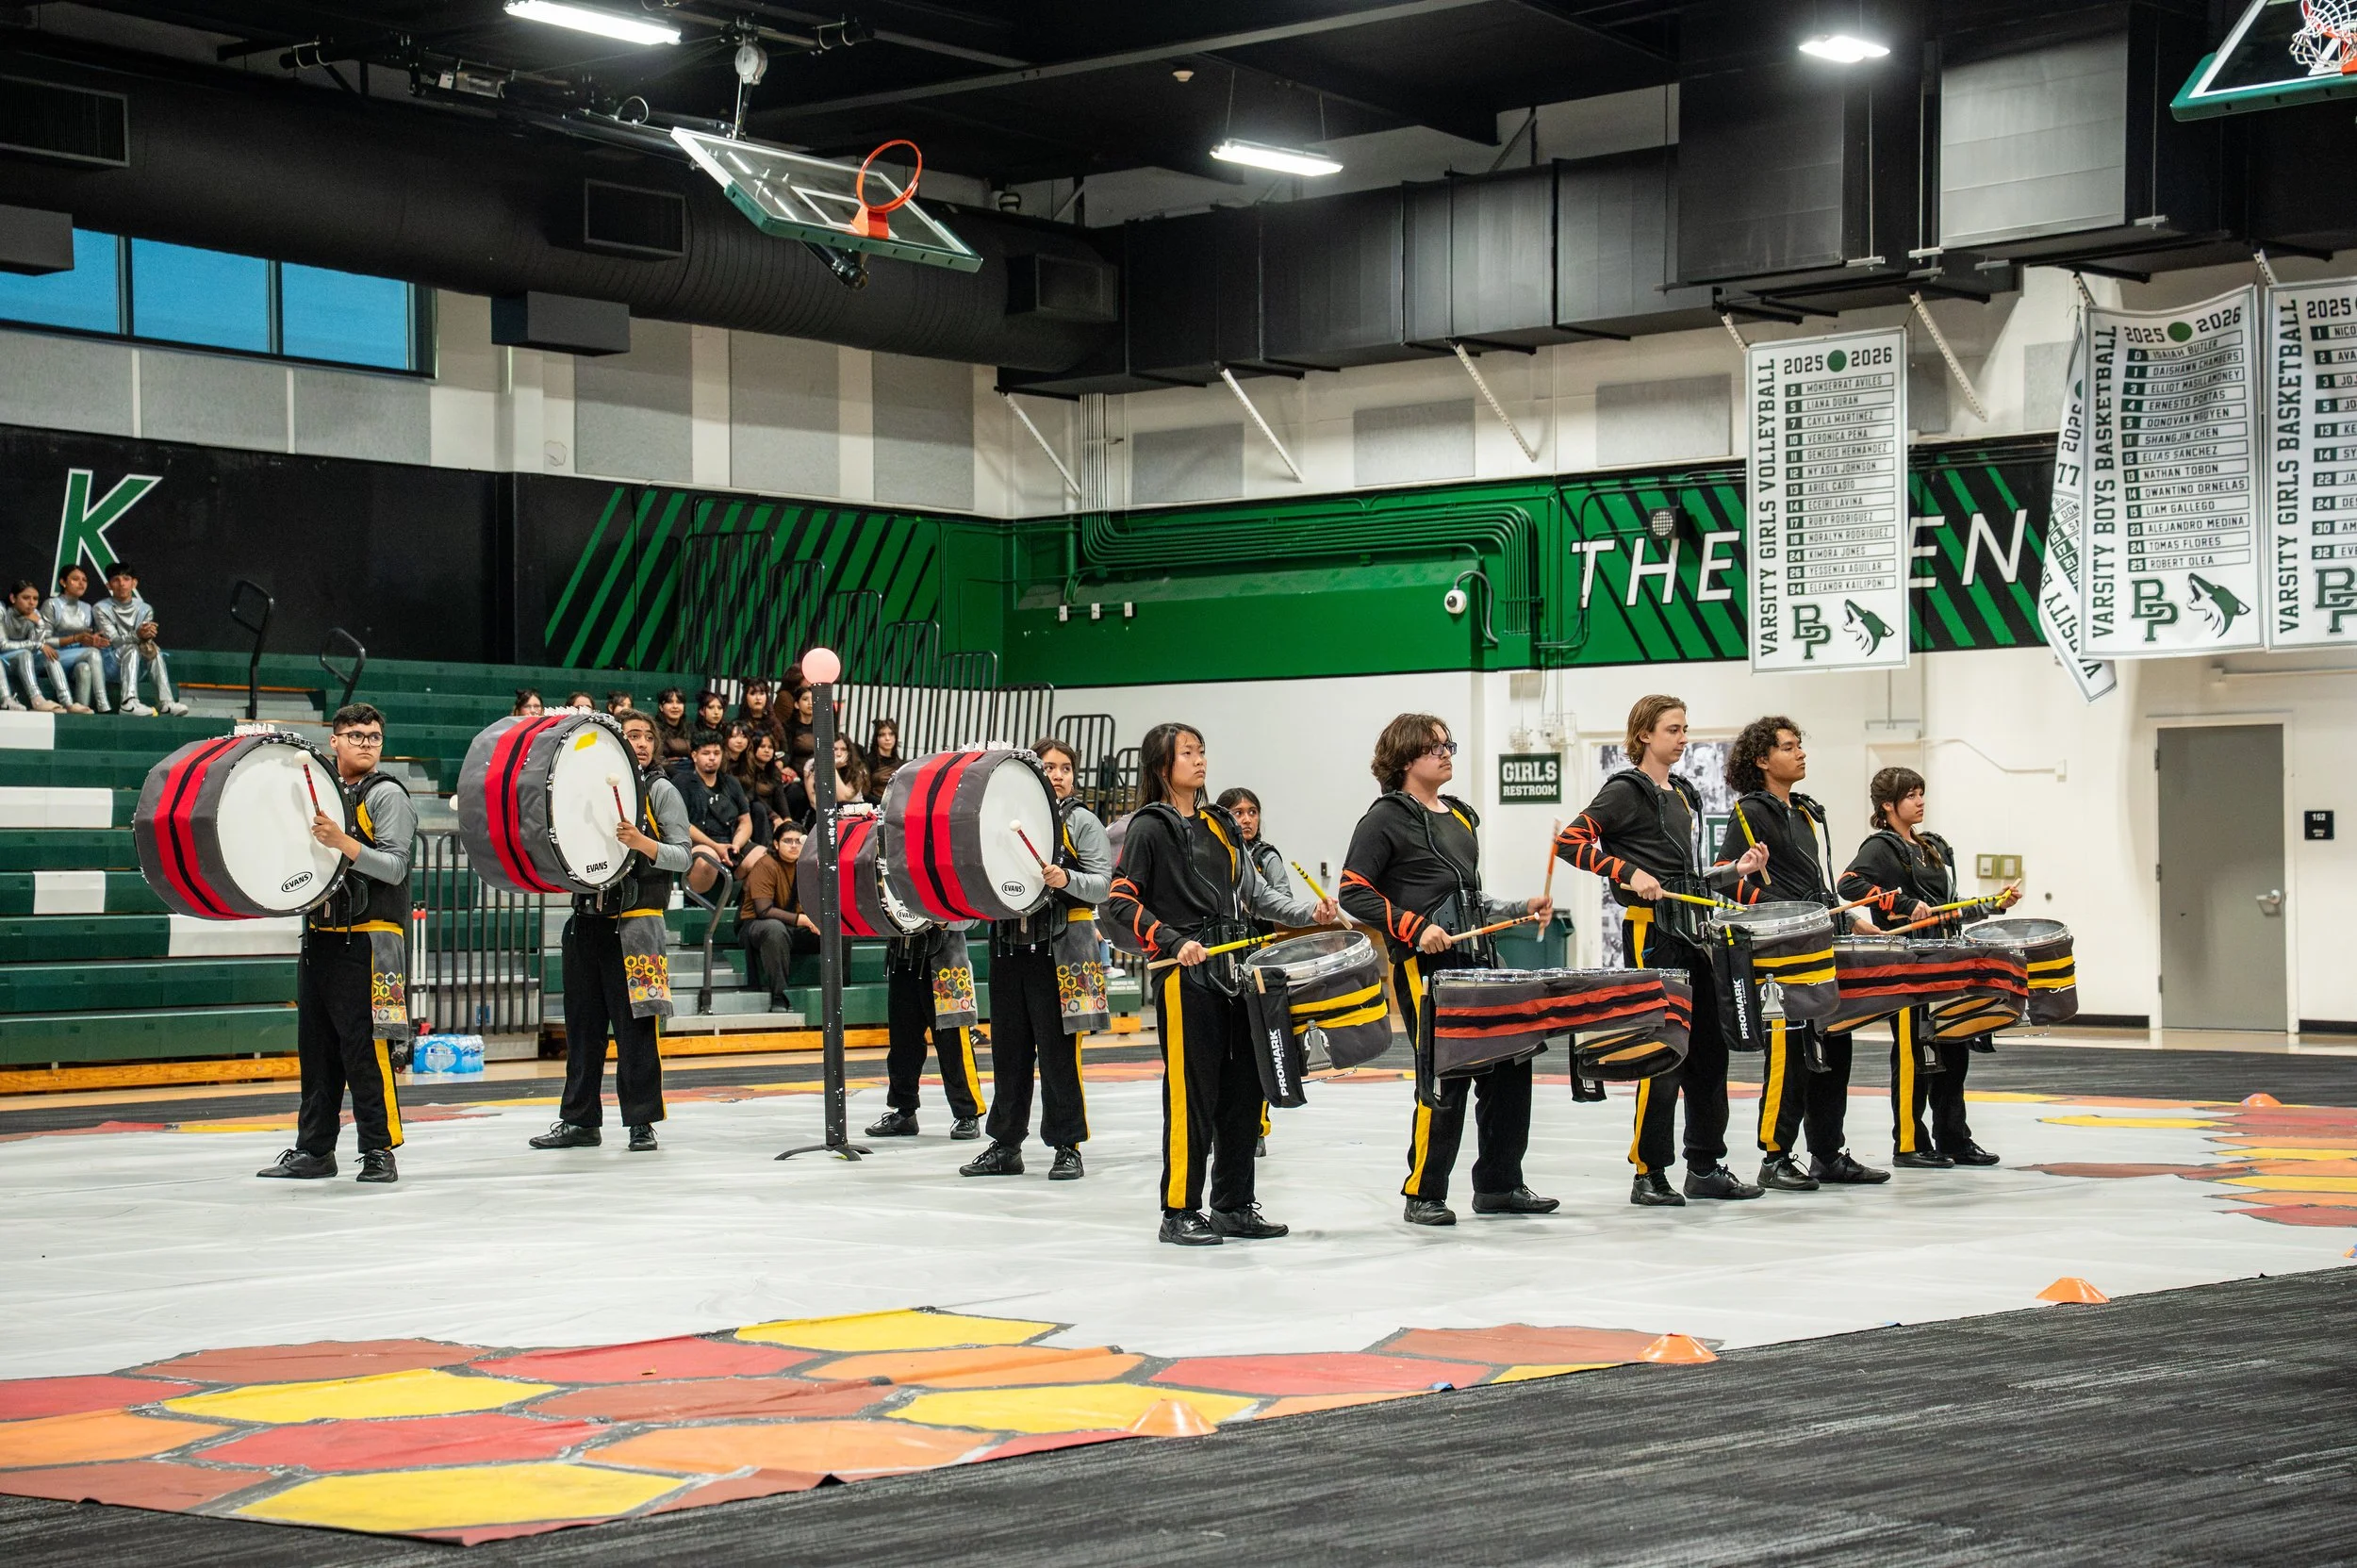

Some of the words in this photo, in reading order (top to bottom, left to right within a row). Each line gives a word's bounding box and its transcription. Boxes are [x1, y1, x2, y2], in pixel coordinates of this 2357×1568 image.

[2307, 298, 2352, 319] 2025
[2124, 326, 2166, 343] 2025
[2196, 306, 2242, 333] 2026
[2187, 339, 2218, 355] BUTLER
[1784, 355, 1823, 374] 2025
[1851, 347, 1892, 367] 2026
[2199, 352, 2239, 368] CHAMBERS
[2319, 353, 2326, 363] 2
[2277, 299, 2302, 452] BASKETBALL
[2322, 376, 2329, 387] 3
[1807, 379, 1852, 392] MONSERRAT
[1855, 376, 1882, 388] AVILES
[2131, 385, 2137, 394] 3
[2151, 382, 2180, 393] ELLIOT
[1833, 396, 1858, 407] DURAN
[2095, 325, 2117, 471] BASKETBALL
[2128, 401, 2135, 411] 4
[2150, 399, 2190, 410] ERNESTO
[2322, 401, 2330, 411] 5
[1758, 358, 1776, 493] VOLLEYBALL
[1807, 414, 1832, 426] CAYLA
[1835, 411, 1873, 423] MARTINEZ
[2126, 418, 2134, 428] 5
[2147, 415, 2190, 428] DONOVAN
[1807, 431, 1845, 443] VERONICA
[2145, 432, 2191, 445] SHANGJIN
[2194, 427, 2218, 438] CHEN
[2319, 425, 2332, 436] 13
[1807, 448, 1838, 460] GENESIS
[1841, 443, 1887, 456] HERNANDEZ
[2125, 454, 2134, 464] 12
[2143, 450, 2169, 462] ELIAS
[2173, 446, 2217, 459] SANCHEZ
[2318, 450, 2332, 460] 14
[1789, 469, 1799, 478] 12
[1841, 462, 1876, 473] JOHNSON
[2144, 467, 2181, 479] NATHAN
[2185, 464, 2218, 476] TOBON
[1808, 481, 1830, 492] ARIEL
[1832, 480, 1855, 491] CASIO
[2316, 474, 2332, 485] 22
[2127, 488, 2137, 500] 14
[2198, 480, 2245, 494] ORNELAS
[2277, 460, 2299, 525] GIRLS
[1790, 502, 1800, 511] 14
[1835, 497, 1863, 507] LAVINA
[2094, 479, 2115, 535] BOYS
[2146, 504, 2167, 516] LIAM
[2170, 501, 2216, 513] GALLEGO
[2316, 499, 2331, 509] 24
[1790, 519, 1799, 528] 17
[1808, 515, 1827, 525] RUBY
[1831, 512, 1873, 523] RODRIGUEZ
[2131, 524, 2141, 535] 23
[2148, 520, 2203, 533] ALEJANDRO
[2207, 517, 2244, 528] MEDINA
[50, 468, 164, 601] K
[1759, 500, 1777, 559] GIRLS
[1846, 528, 1888, 539] RODRIGUEZ
[2316, 523, 2331, 534] 30
[2055, 543, 2068, 556] 17
[2131, 542, 2143, 553] 24
[2150, 540, 2180, 551] TOMAS
[2183, 536, 2221, 548] FLORES
[2315, 547, 2331, 558] 32
[1571, 530, 1741, 608] THE
[1907, 508, 2028, 589] EN
[1789, 552, 1802, 562] 24
[1809, 548, 1838, 559] KIMORA
[1841, 546, 1866, 557] JONES
[2063, 555, 2077, 569] 21
[1789, 568, 1802, 578] 26
[1809, 565, 1845, 576] YESSENIA
[1849, 562, 1882, 573] AGUILAR
[2131, 560, 2144, 570] 25
[2151, 557, 2184, 569] ROBERT
[2188, 555, 2215, 567] OLEA
[1809, 582, 1843, 593] ELEANOR
[2092, 544, 2115, 639] VARSITY
[2278, 536, 2299, 634] VARSITY
[1760, 569, 1778, 657] VARSITY
[1502, 761, 1558, 783] GIRLS
[1503, 784, 1558, 797] RESTROOM
[586, 861, 608, 874] EVANS
[284, 873, 309, 890] EVANS
[1004, 884, 1022, 893] EVANS
[898, 910, 915, 919] EVANS
[1733, 978, 1750, 1040] PROMARK
[1268, 1028, 1290, 1097] PROMARK
